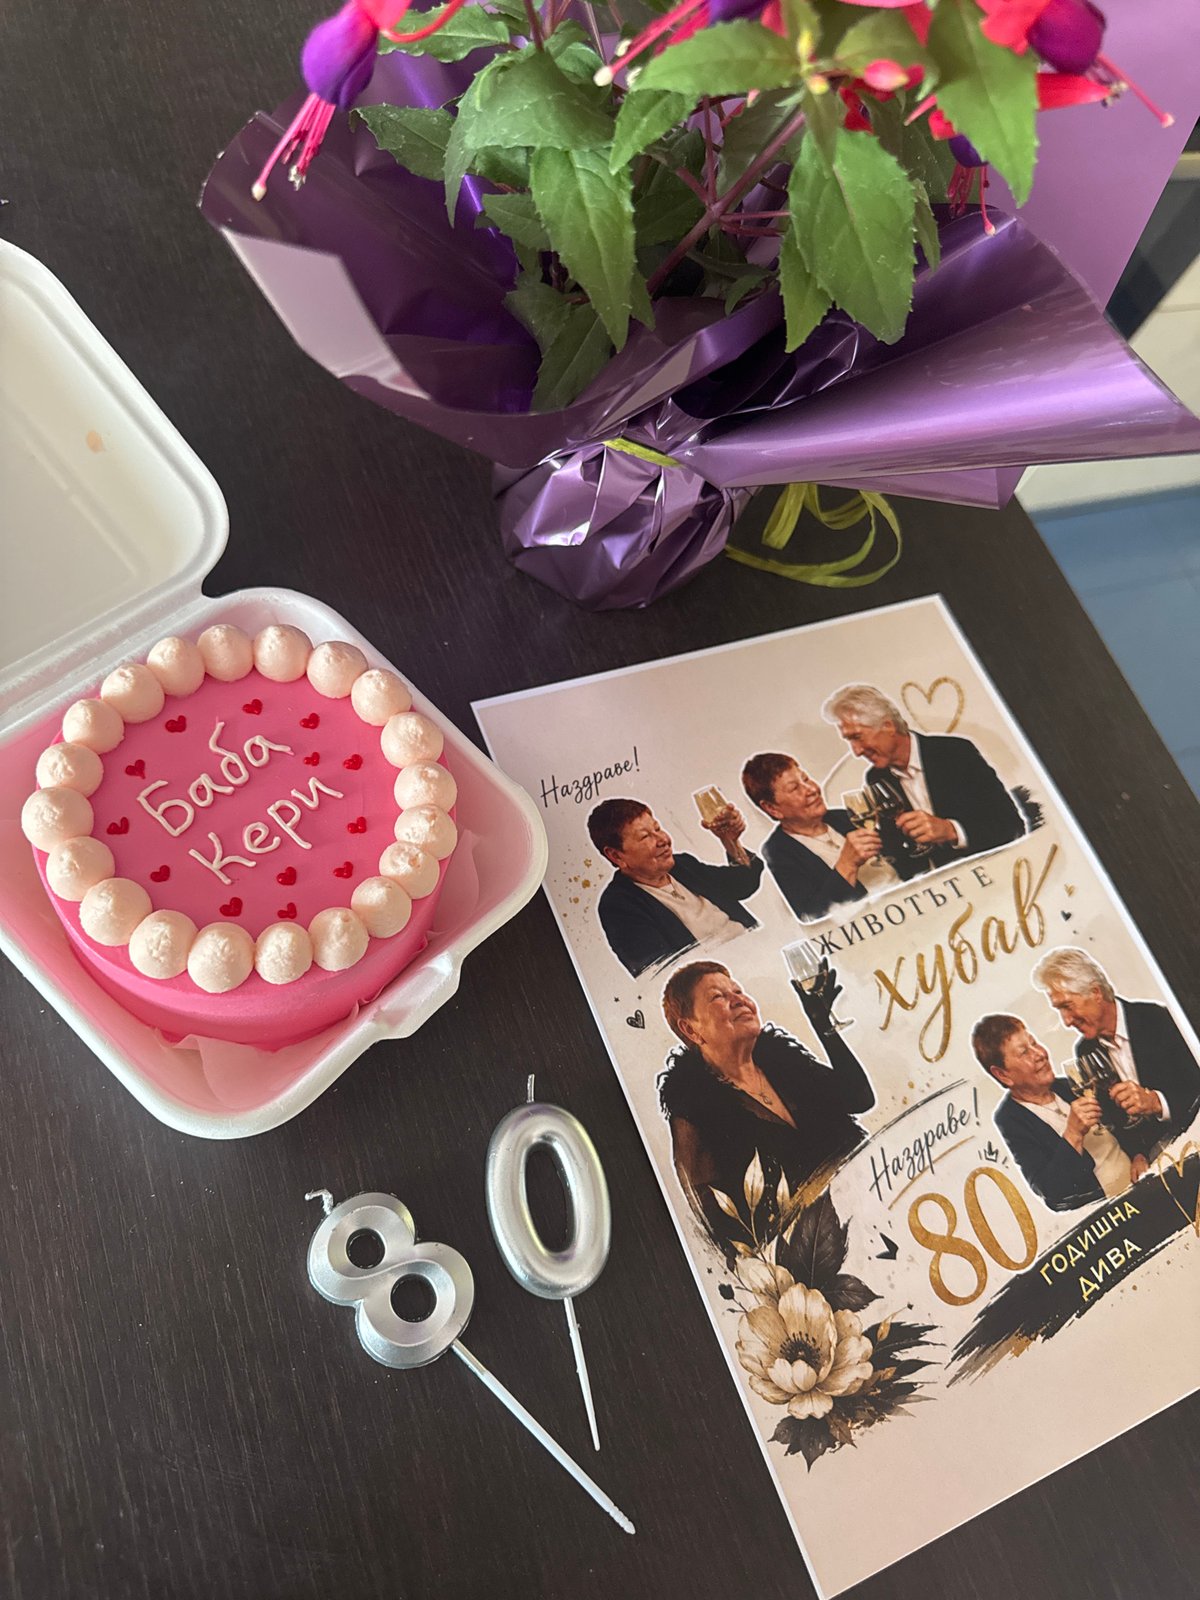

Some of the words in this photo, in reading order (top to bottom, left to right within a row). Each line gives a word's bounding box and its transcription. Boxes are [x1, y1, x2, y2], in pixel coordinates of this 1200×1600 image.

[136, 719, 295, 837] Баба
[188, 776, 345, 885] Кери
[540, 745, 641, 808] Наздраве!
[810, 876, 962, 955] ЖИВОТЪТ
[971, 865, 994, 888] Е
[873, 842, 1059, 1063] хубав
[868, 1086, 981, 1201] Наздраве!
[907, 1166, 1039, 1307] 80
[1038, 1200, 1142, 1285] ГОДИШНА
[1077, 1237, 1143, 1302] ДИВА
